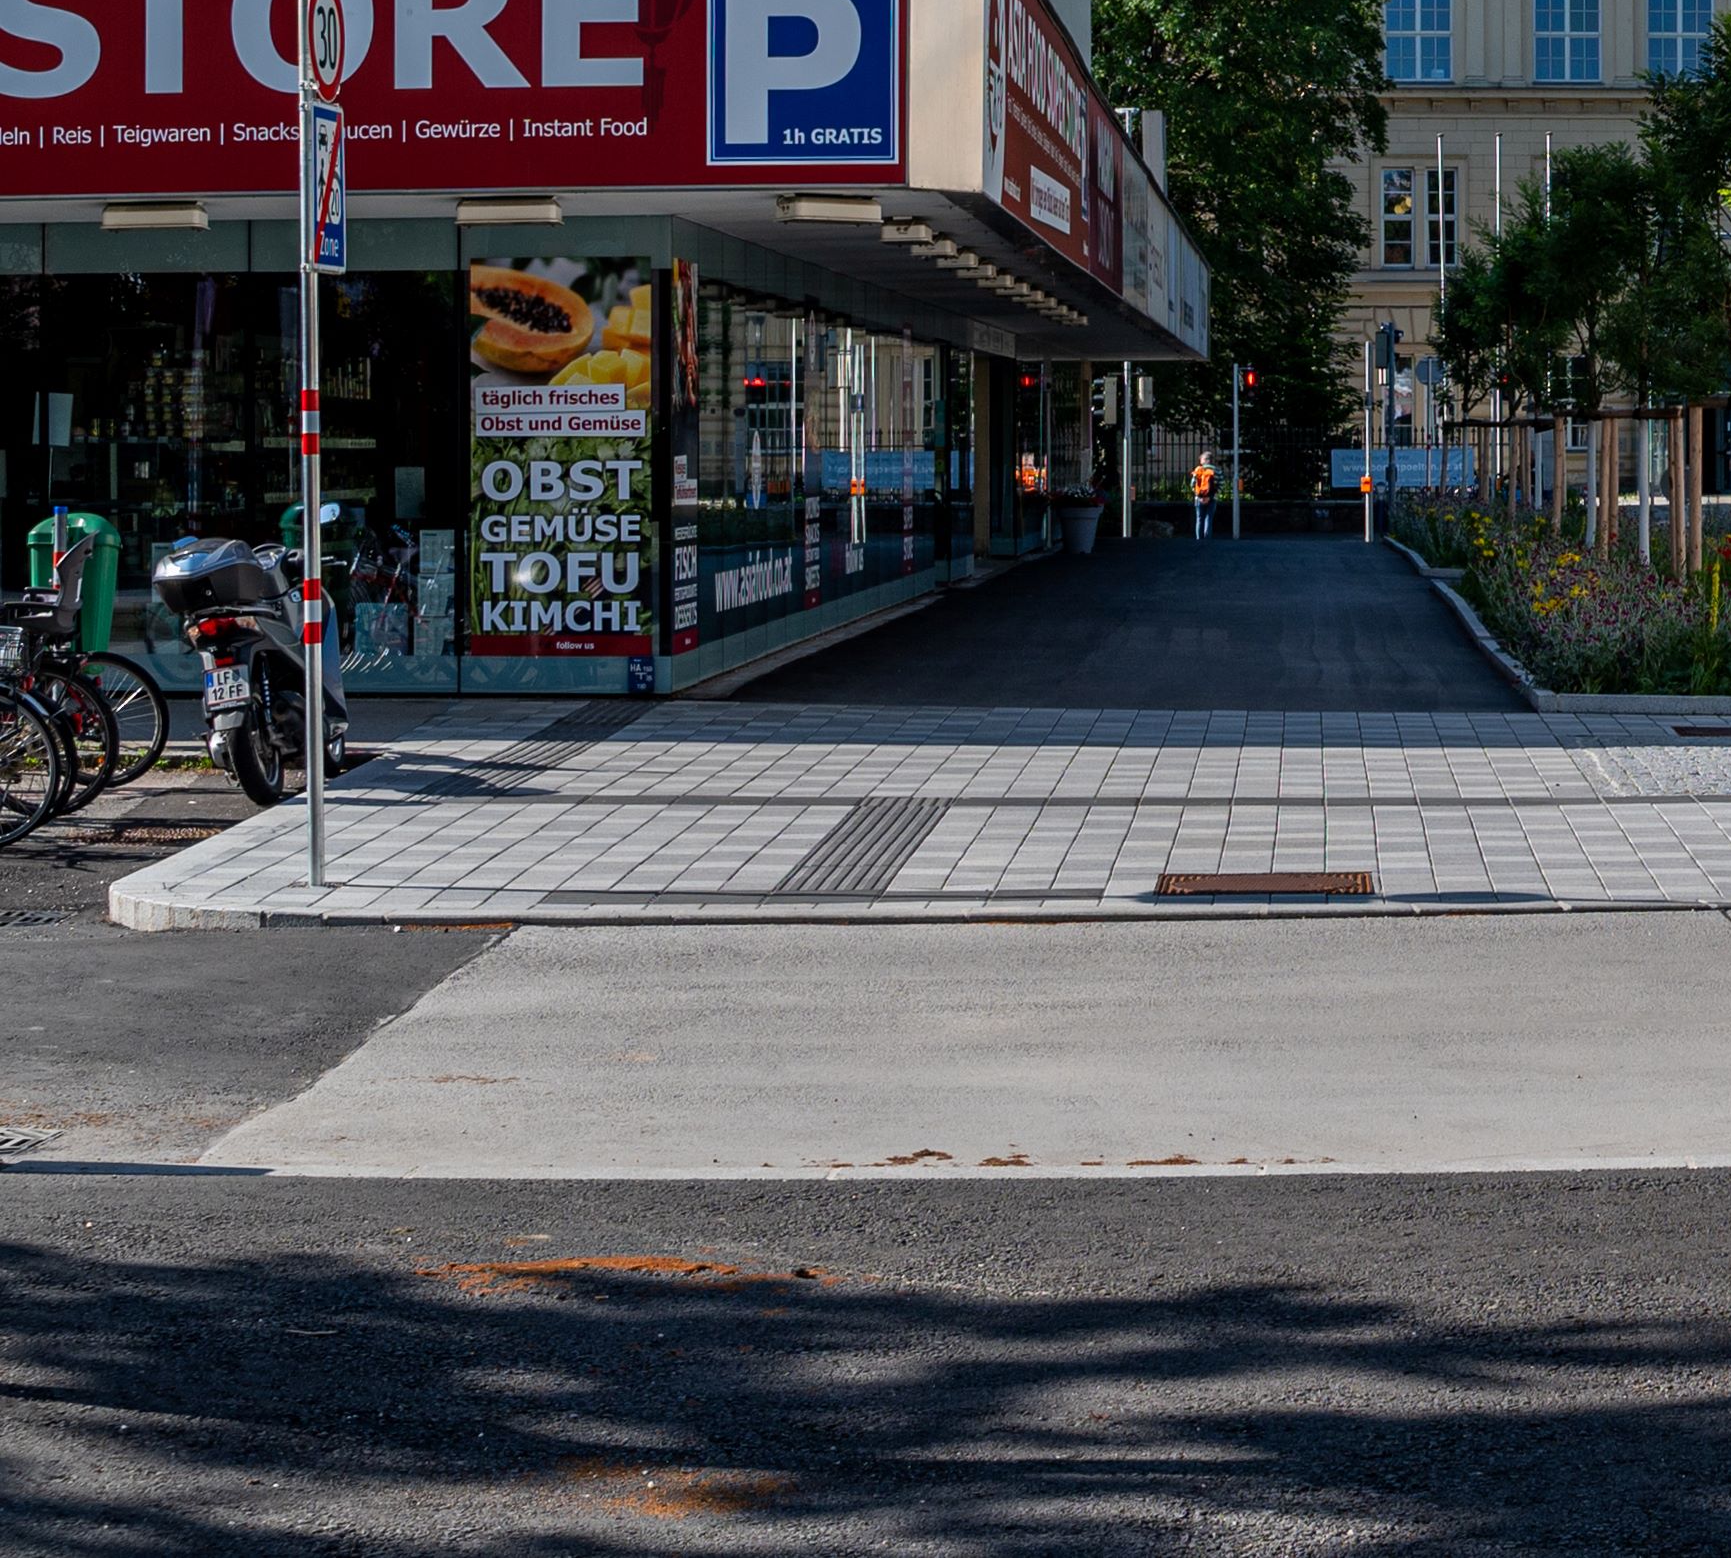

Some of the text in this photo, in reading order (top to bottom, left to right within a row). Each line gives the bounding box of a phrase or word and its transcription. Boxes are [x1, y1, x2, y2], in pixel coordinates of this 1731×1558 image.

[316, 6, 338, 70] 30
[1027, 14, 1046, 115] FOOD
[53, 125, 92, 144] Reis
[112, 125, 211, 147] Teigwaren
[233, 123, 300, 141] Snacks
[344, 124, 393, 140] ucen
[415, 119, 501, 139] Gewürze
[523, 118, 594, 137] Instant
[600, 117, 648, 137] Food
[783, 127, 882, 145] 1h GRATIS
[320, 230, 339, 257] Zone
[481, 389, 620, 409] täglich frisches
[481, 415, 642, 431] Obst und Gemüse
[481, 459, 643, 502] OBST
[480, 507, 642, 543] GEMÜSE
[480, 551, 640, 594] TOFU
[715, 547, 793, 613] www.asiafood.co.at
[481, 599, 642, 633] KIMCHI
[556, 641, 582, 650] follow
[212, 683, 243, 701] 12 FF
[217, 671, 230, 686] LF
